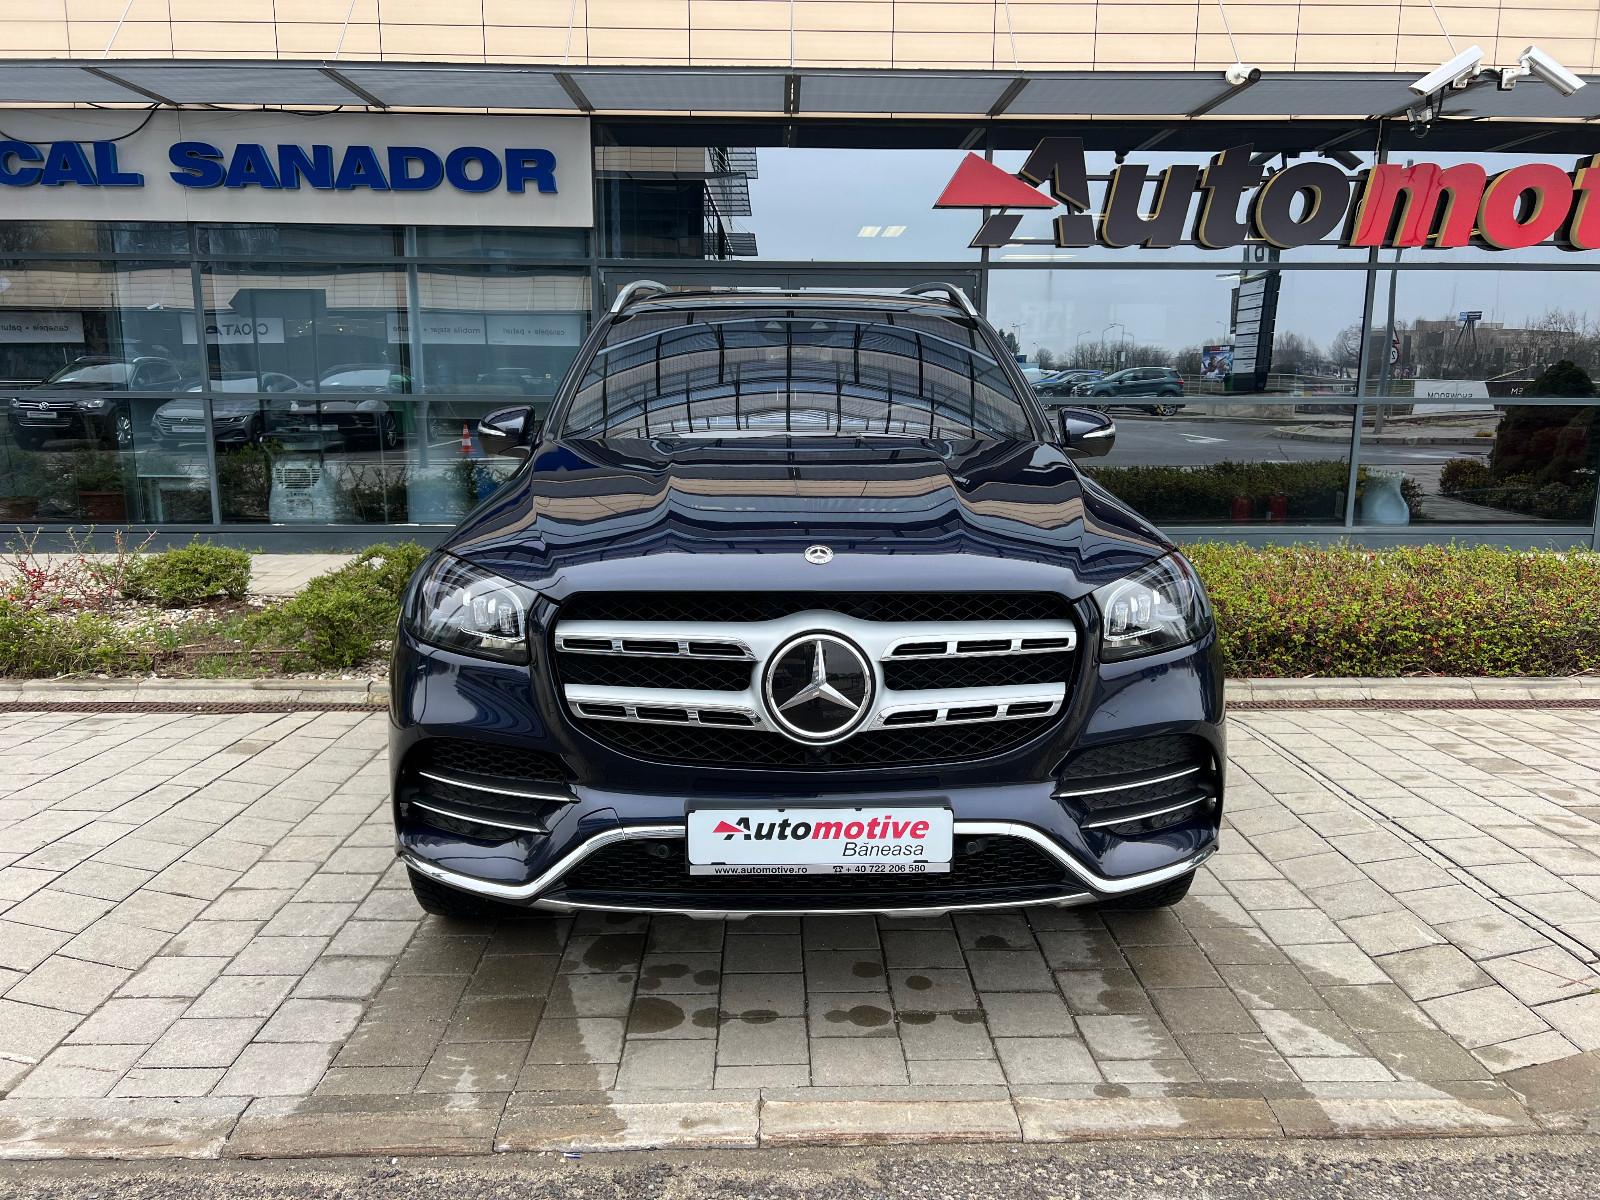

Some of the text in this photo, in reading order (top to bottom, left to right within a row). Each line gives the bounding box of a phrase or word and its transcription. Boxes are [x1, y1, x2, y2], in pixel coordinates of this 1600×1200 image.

[0, 140, 558, 194] CAL SANADOR
[713, 815, 930, 841] Automotive
[714, 866, 808, 874] www.automotive.ro
[854, 865, 866, 873] 40
[869, 865, 886, 873] 722
[888, 865, 906, 873] 206
